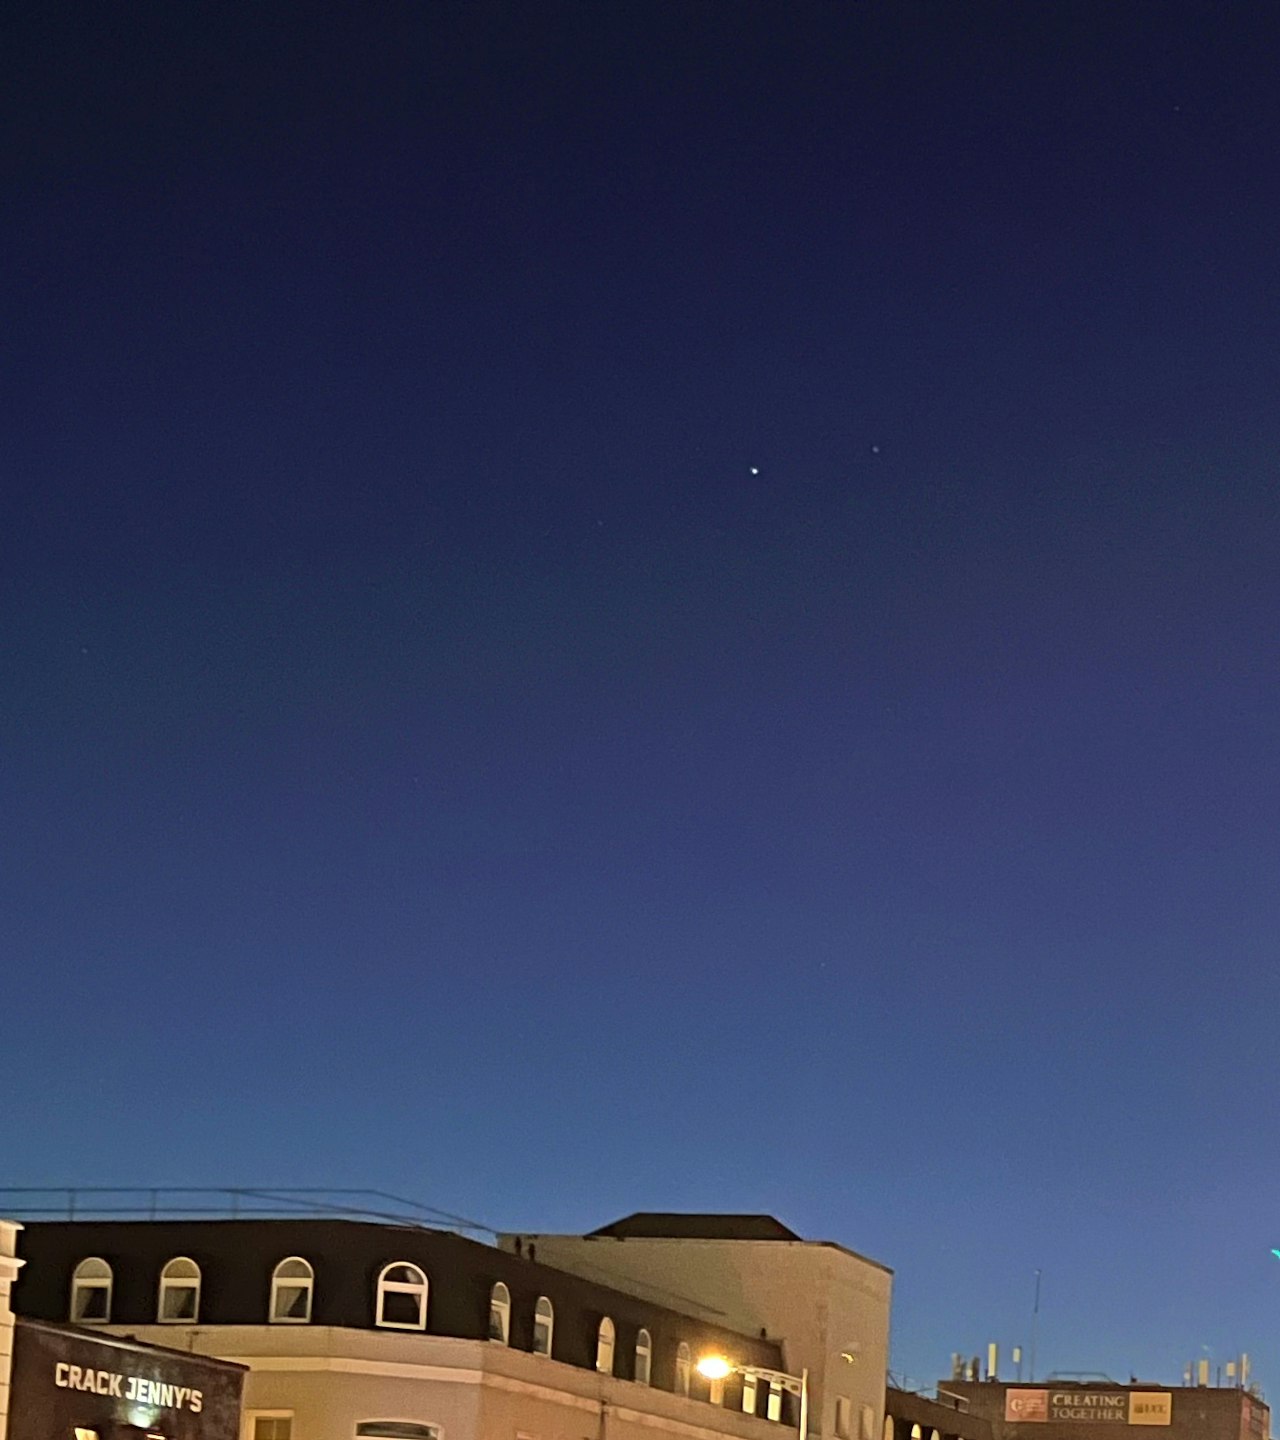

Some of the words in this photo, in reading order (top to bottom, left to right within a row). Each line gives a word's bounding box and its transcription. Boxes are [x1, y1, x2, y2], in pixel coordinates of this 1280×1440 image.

[55, 1362, 123, 1398] CRACK
[125, 1377, 203, 1413] JENNY'S
[1053, 1394, 1125, 1406] CREATING
[1052, 1408, 1126, 1420] TOGETHER
